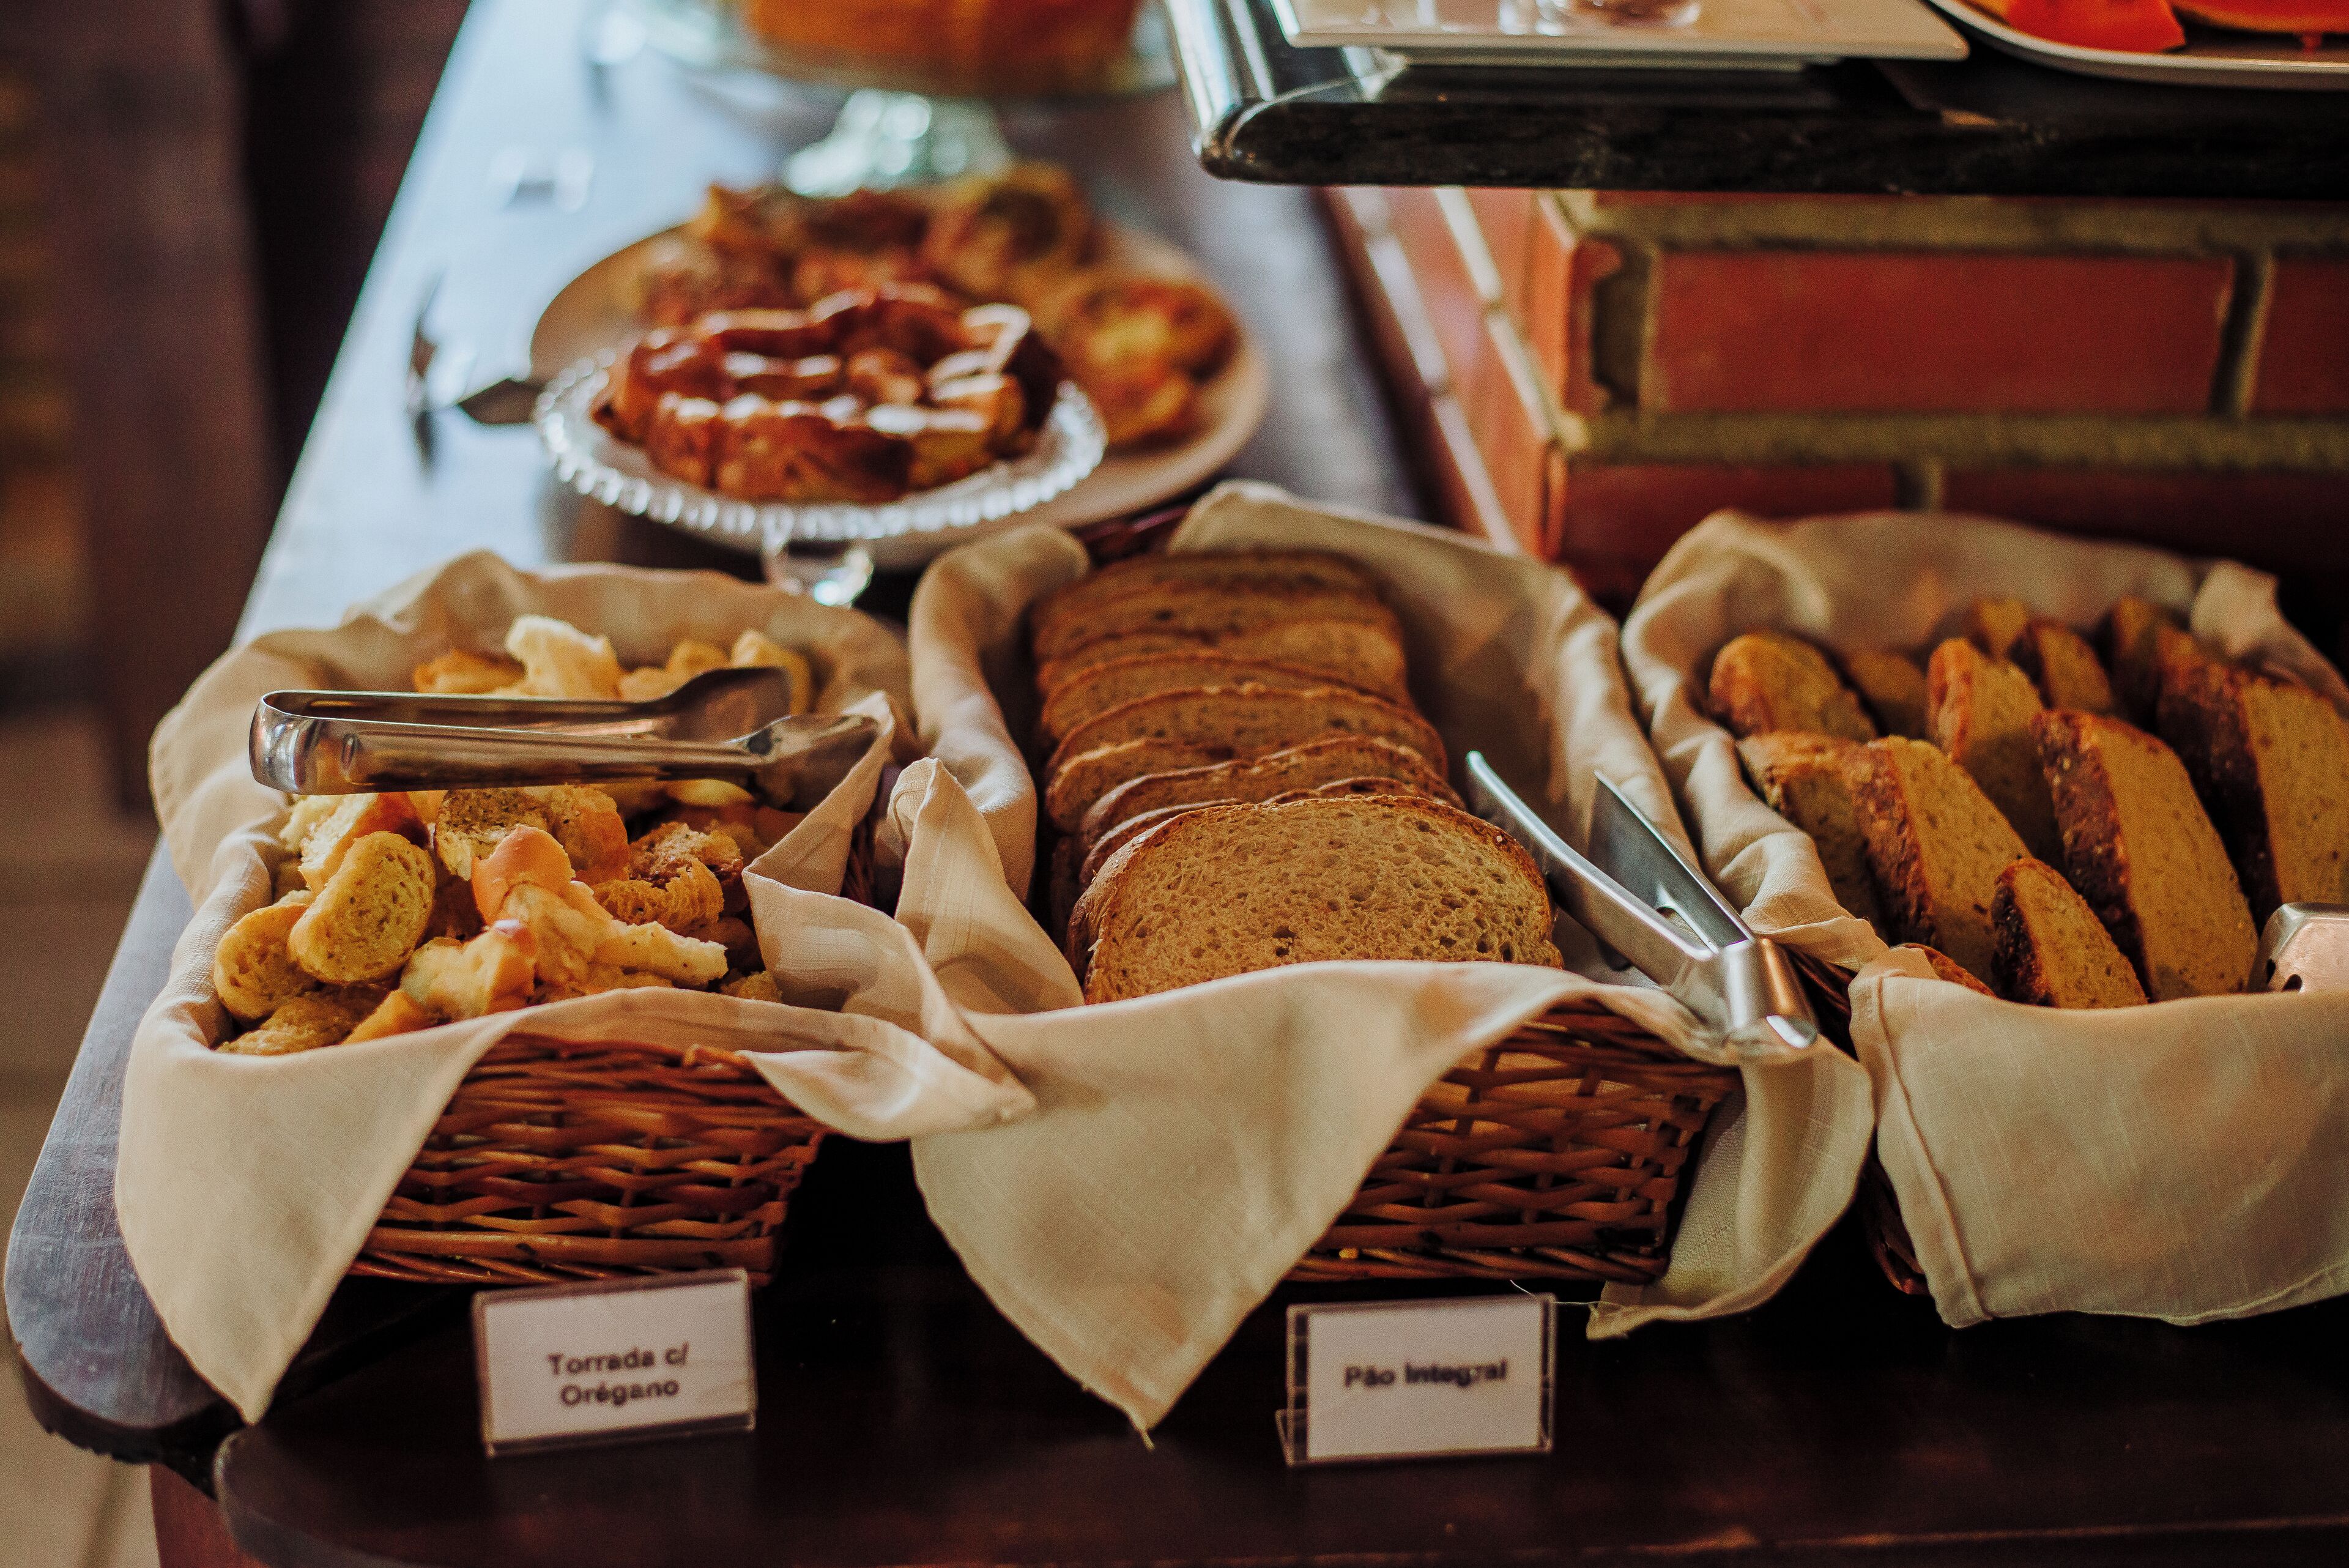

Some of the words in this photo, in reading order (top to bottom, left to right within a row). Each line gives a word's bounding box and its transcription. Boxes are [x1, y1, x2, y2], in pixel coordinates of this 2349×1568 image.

[548, 1347, 655, 1375] Torrada
[664, 1342, 689, 1365] c/
[1406, 1358, 1507, 1387] Integral
[560, 1380, 680, 1406] Orégano
